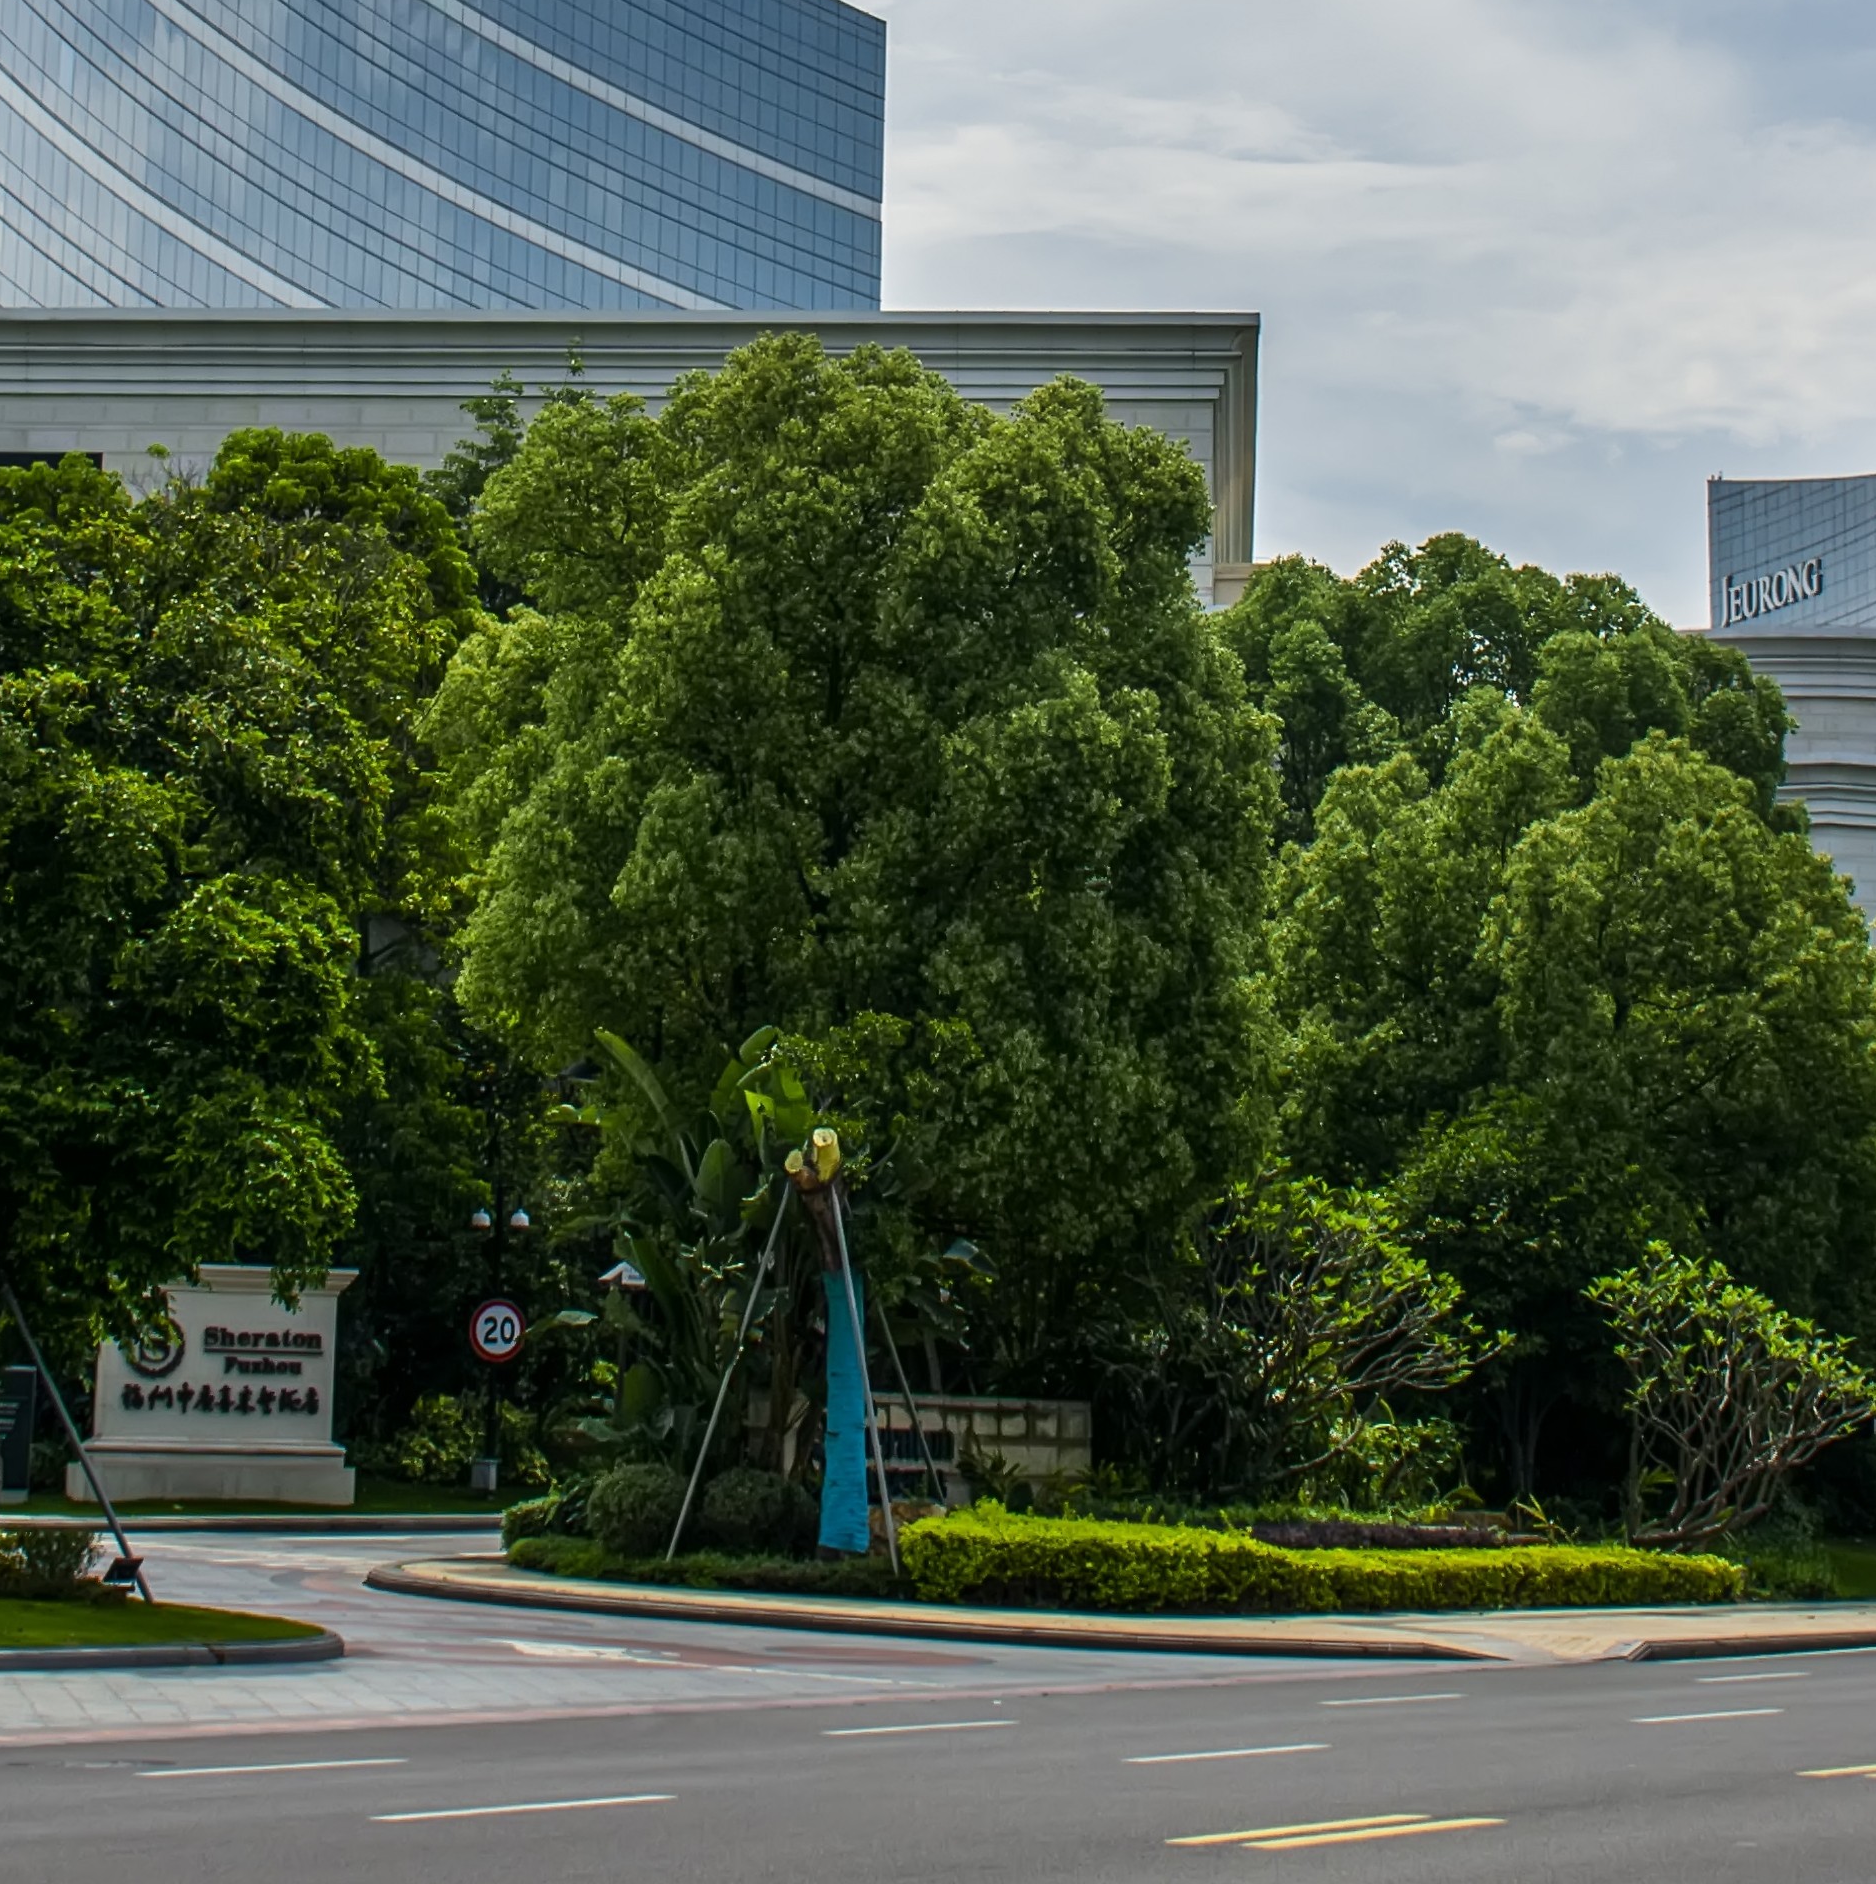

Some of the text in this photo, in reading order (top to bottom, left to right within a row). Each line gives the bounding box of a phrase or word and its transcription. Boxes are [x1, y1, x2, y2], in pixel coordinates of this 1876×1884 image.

[1721, 557, 1824, 629] JEURONG
[203, 1325, 323, 1349] Sheraton
[482, 1314, 516, 1346] 20
